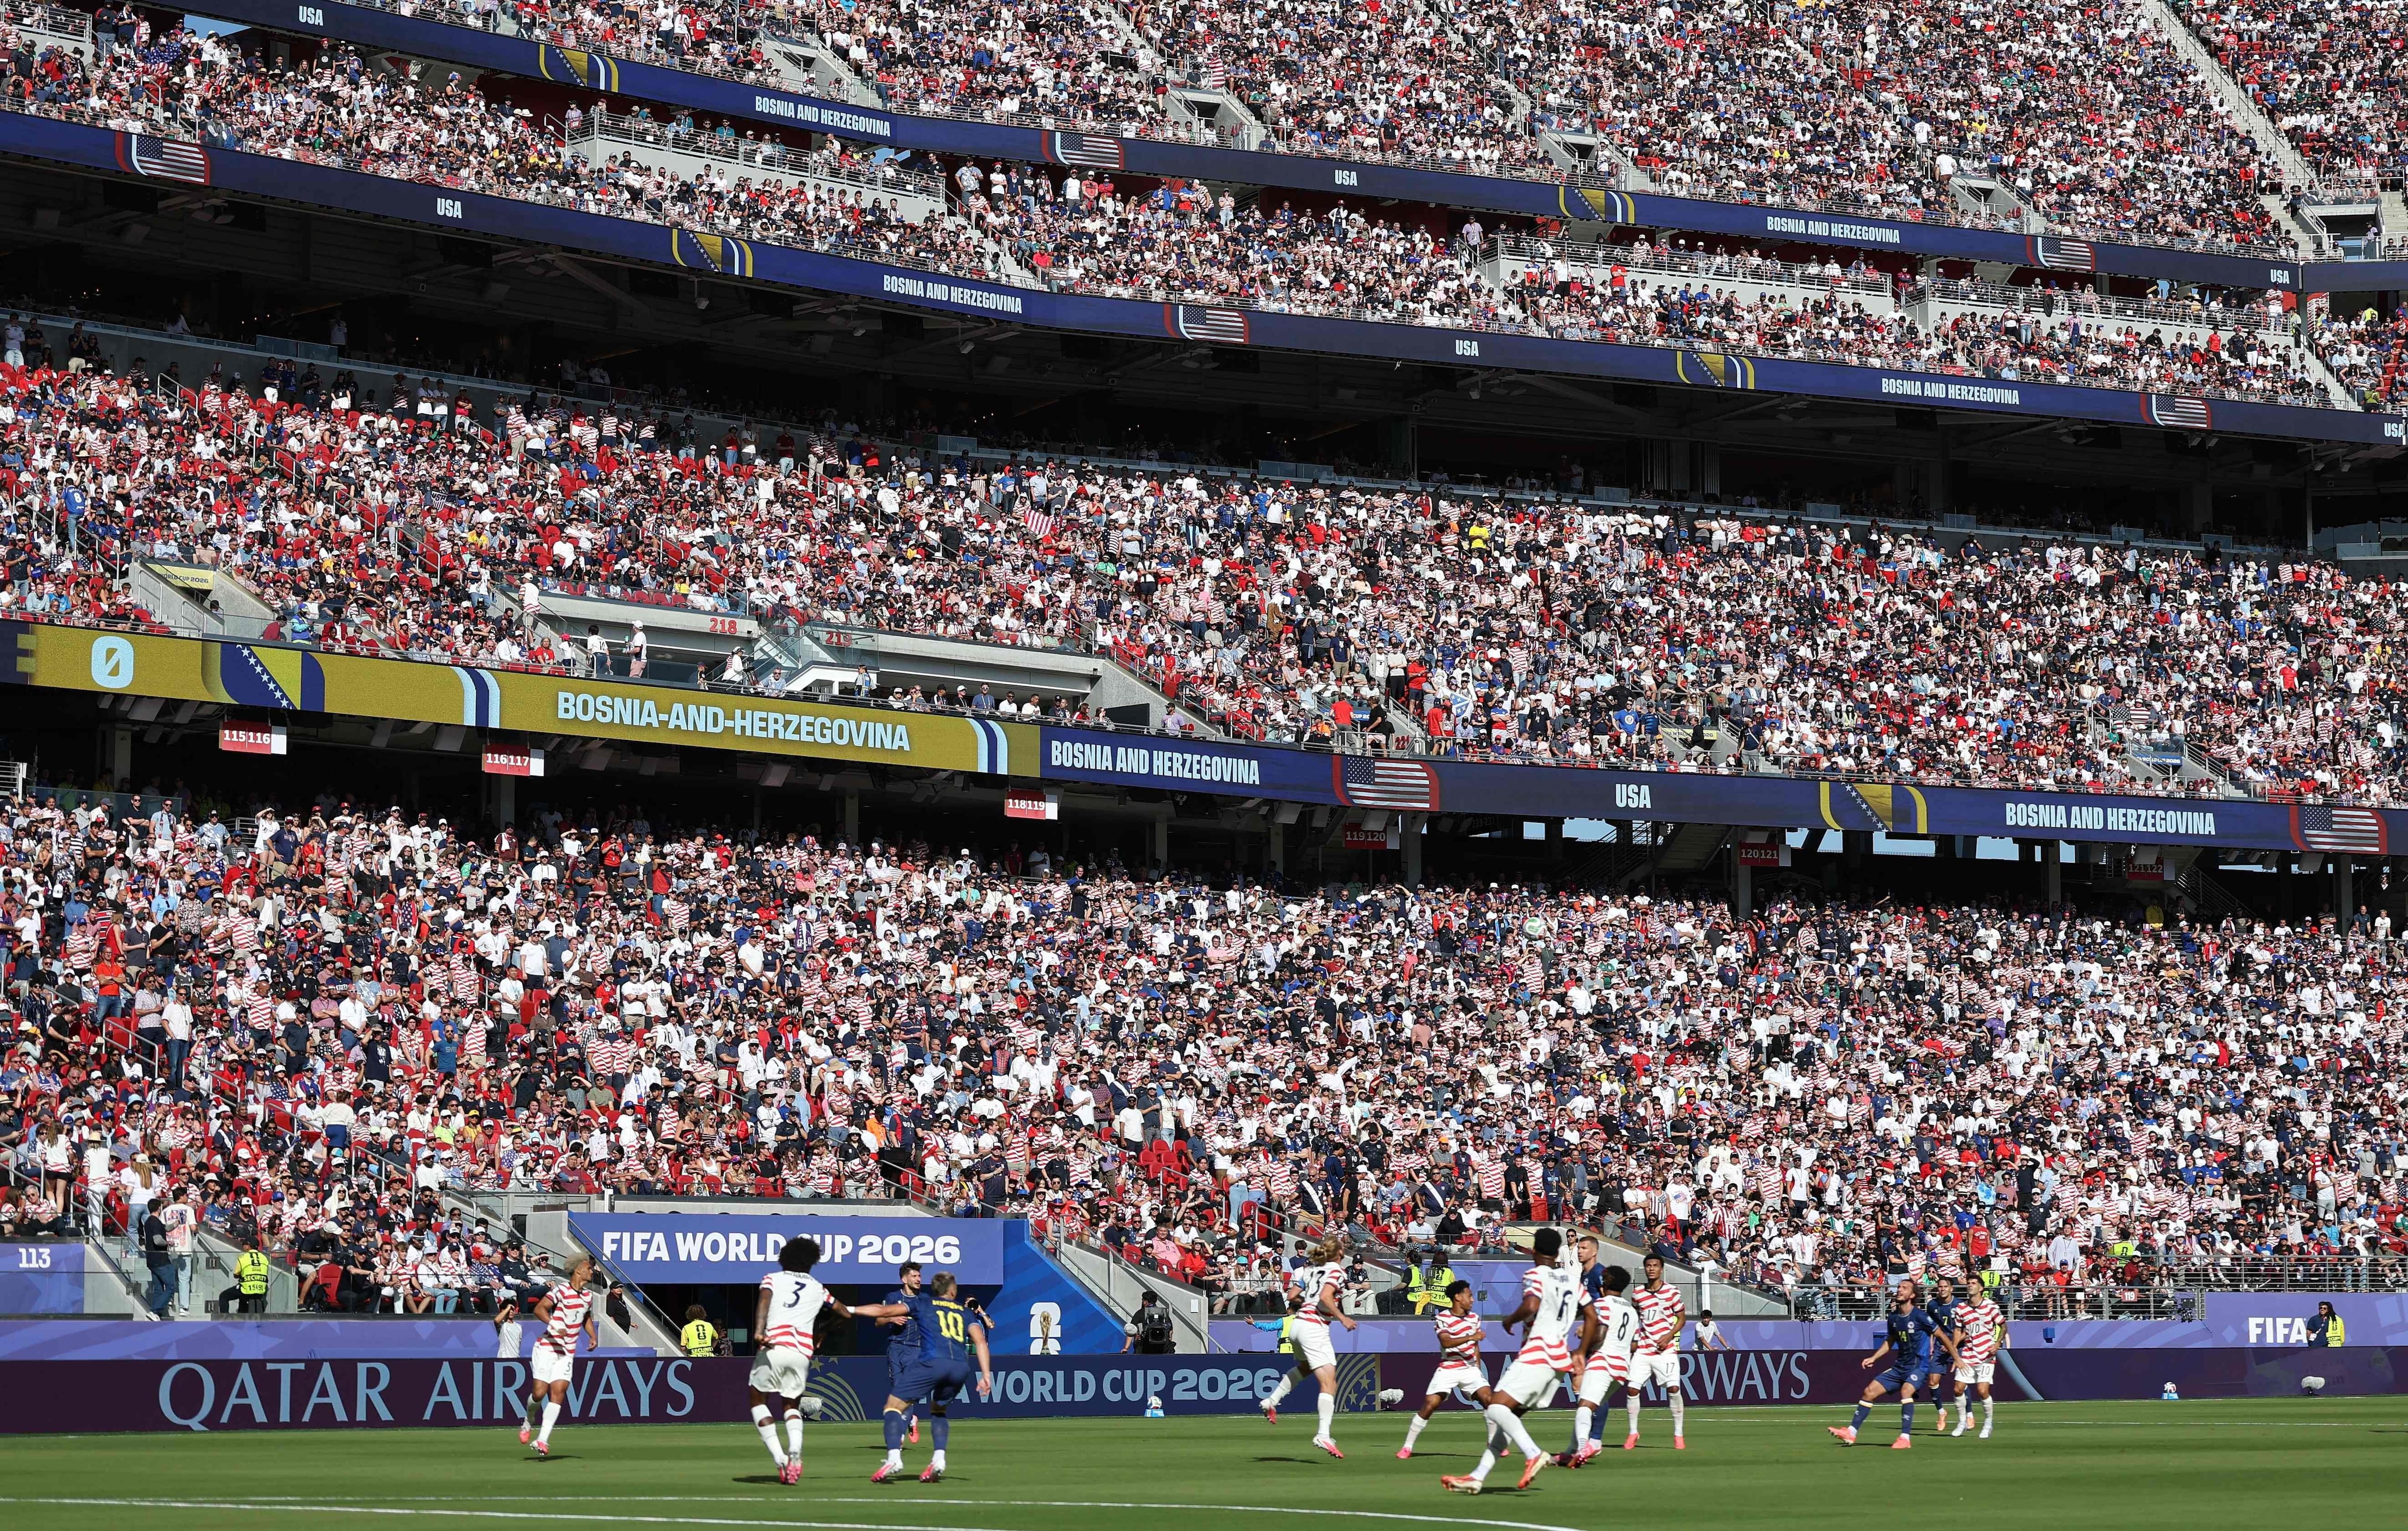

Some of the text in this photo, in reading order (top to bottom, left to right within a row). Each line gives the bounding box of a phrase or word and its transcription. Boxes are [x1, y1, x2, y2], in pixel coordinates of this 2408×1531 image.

[299, 6, 324, 26] USA
[756, 96, 890, 136] BOSNIA AND HERZEGOVINA
[1335, 170, 1358, 186] USA
[437, 198, 462, 219] USA
[1767, 216, 1900, 243] BOSNIA AND HERZEGOVINA
[2271, 269, 2290, 284] USA
[884, 275, 1022, 313] BOSNIA AND HERZEGOVINA
[1456, 340, 1479, 356] USA
[1882, 378, 2019, 404] BOSNIA AND HERZEGOVINA
[73, 492, 81, 503] 8
[432, 492, 446, 501] USA
[709, 618, 737, 634] 218
[558, 692, 910, 751] BOSNIA-AND-HERZEGOVINA
[224, 730, 271, 744] 115 116
[1396, 735, 1411, 750] 221
[486, 753, 529, 766] 116 117
[1052, 740, 1259, 784] BOSNIA AND HERZEGOVINA
[1616, 784, 1651, 808] USA
[1008, 799, 1045, 811] 118 119
[2006, 803, 2215, 834] BOSNIA AND HERZEGOVINA
[1346, 831, 1386, 841] 119 120
[1741, 849, 1778, 858] 120 121
[987, 1108, 994, 1116] 10
[603, 1232, 961, 1264] FIFA WORLD UP 2026
[19, 1248, 51, 1268] 113
[783, 1281, 807, 1308] 3
[2124, 1292, 2135, 1302] 119
[572, 1311, 579, 1322] 5
[1646, 1309, 1657, 1321] 17
[1942, 1316, 1948, 1326] 7
[936, 1309, 964, 1343] 10
[1617, 1312, 1629, 1341] 8
[1970, 1323, 1980, 1333] 10
[2248, 1318, 2308, 1343] FIFA
[1898, 1330, 1907, 1342] 14
[565, 1361, 572, 1372] 5
[1666, 1362, 1675, 1374] 17
[1980, 1365, 1990, 1373] 10
[975, 1370, 1096, 1403] WORLD
[1102, 1369, 1166, 1402] CUP
[1173, 1369, 1282, 1400] 2026
[159, 1361, 394, 1431] QATAR
